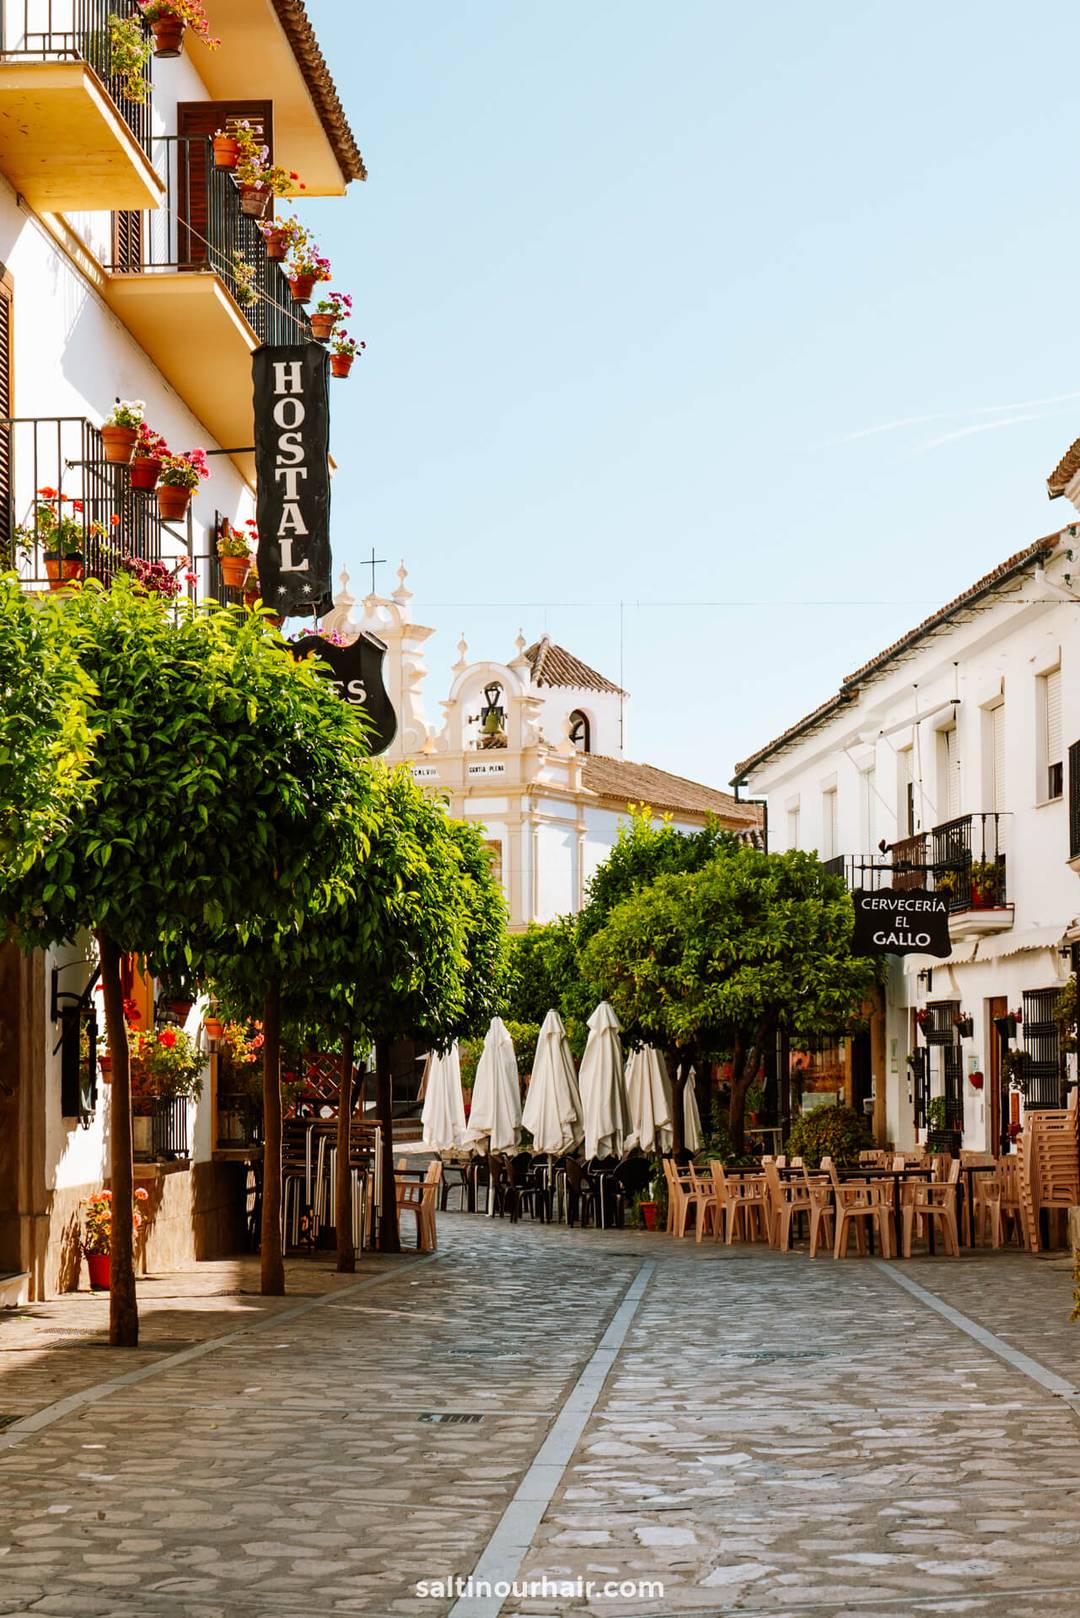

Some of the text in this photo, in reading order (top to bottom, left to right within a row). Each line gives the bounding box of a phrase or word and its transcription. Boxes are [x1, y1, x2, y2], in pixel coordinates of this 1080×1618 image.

[272, 360, 309, 573] HOSTAL
[861, 898, 946, 912] CERVECERÍA
[895, 916, 910, 928] EL
[873, 931, 931, 947] GALLO
